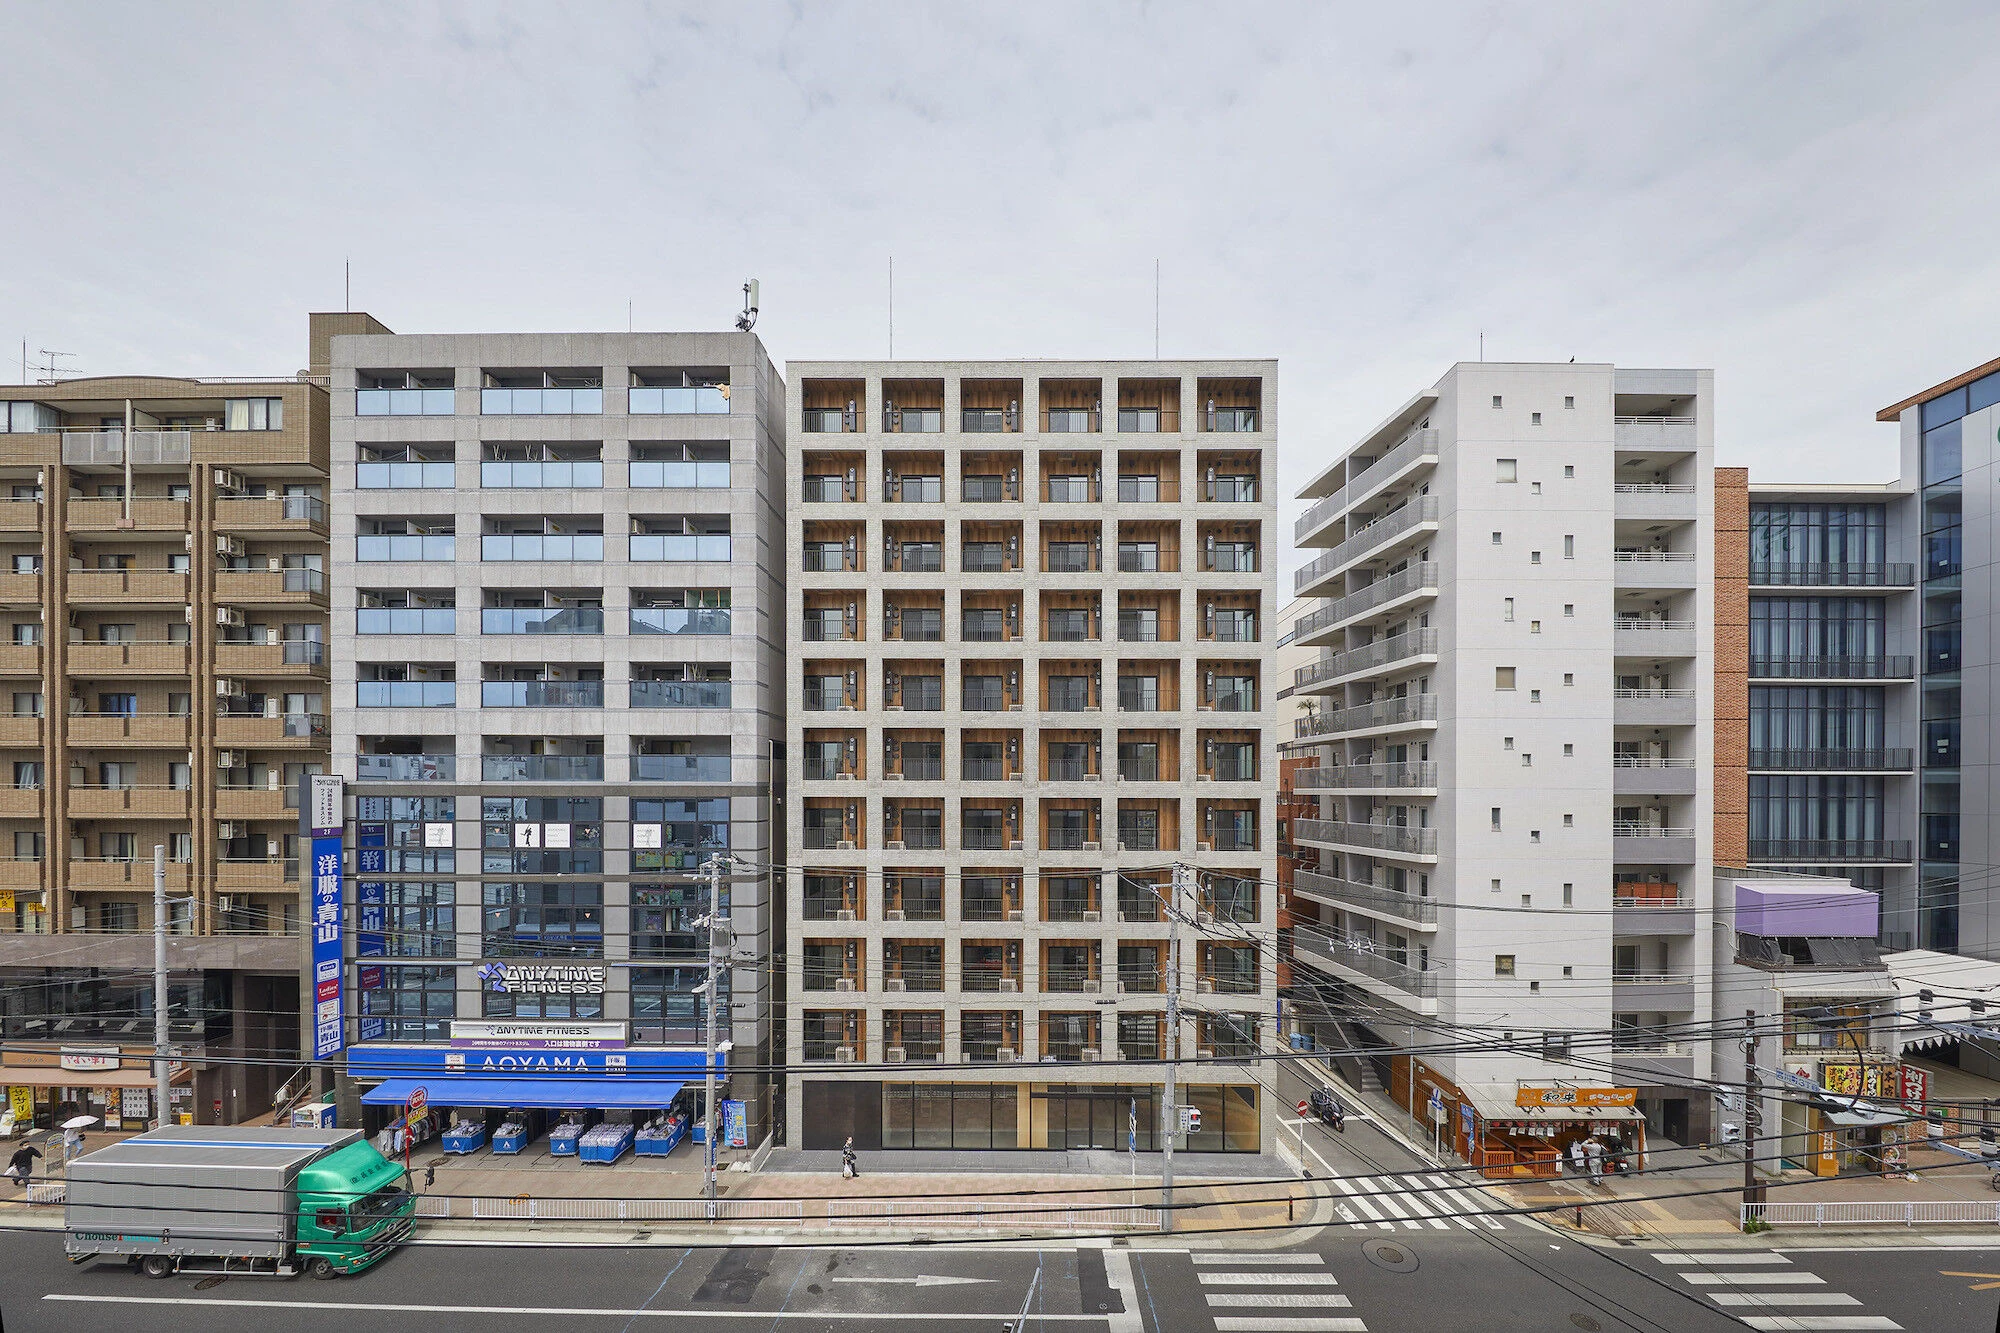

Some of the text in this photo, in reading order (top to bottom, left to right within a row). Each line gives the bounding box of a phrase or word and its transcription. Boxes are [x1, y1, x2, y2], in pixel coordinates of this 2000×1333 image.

[317, 854, 339, 944] 洋服の青山
[506, 965, 605, 981] ANYTIME
[507, 981, 605, 994] FITNESS
[497, 1027, 590, 1035] ANYTIME FITNESS
[482, 1056, 589, 1072] AOYAMA
